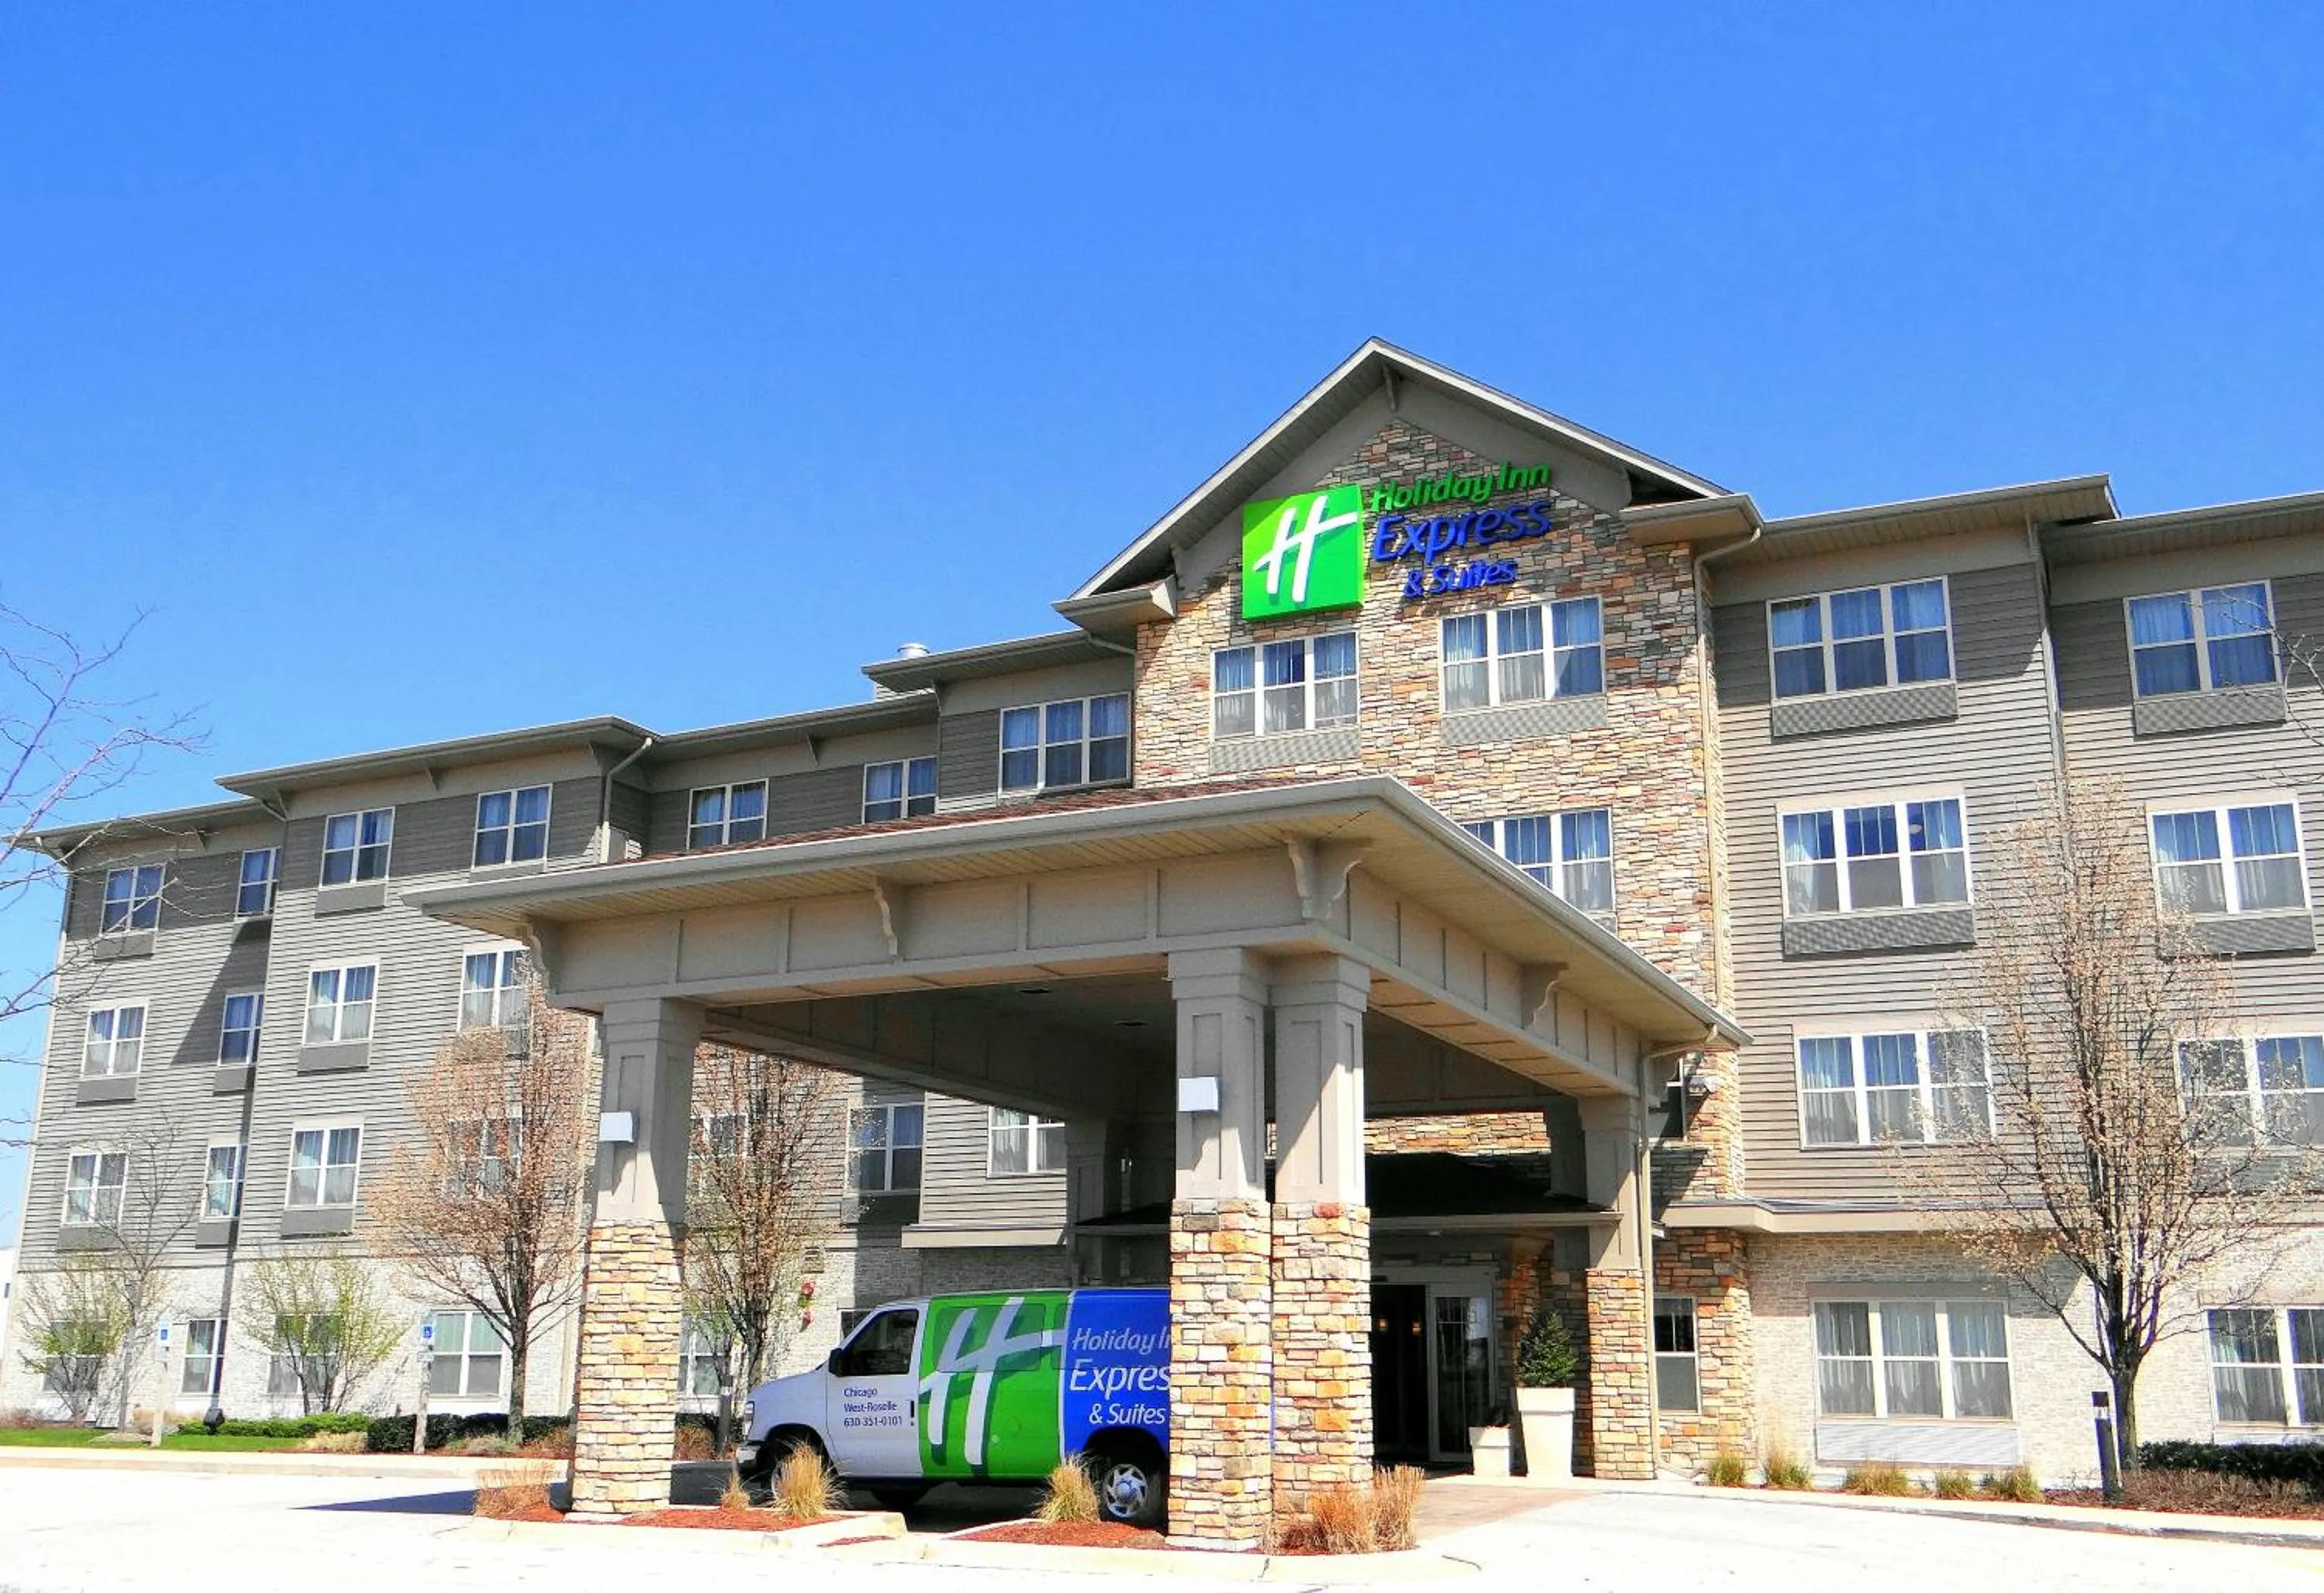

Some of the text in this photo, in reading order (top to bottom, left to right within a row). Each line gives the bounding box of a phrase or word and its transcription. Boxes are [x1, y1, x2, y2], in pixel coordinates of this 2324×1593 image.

[1370, 460, 1550, 512] Holiday Inn
[1372, 500, 1552, 565] Express
[1404, 558, 1520, 598] & Suites
[1072, 1326, 1156, 1354] Holiday
[844, 1388, 878, 1398] Chicago
[1069, 1358, 1171, 1400] Expres
[1088, 1403, 1166, 1425] & Suites
